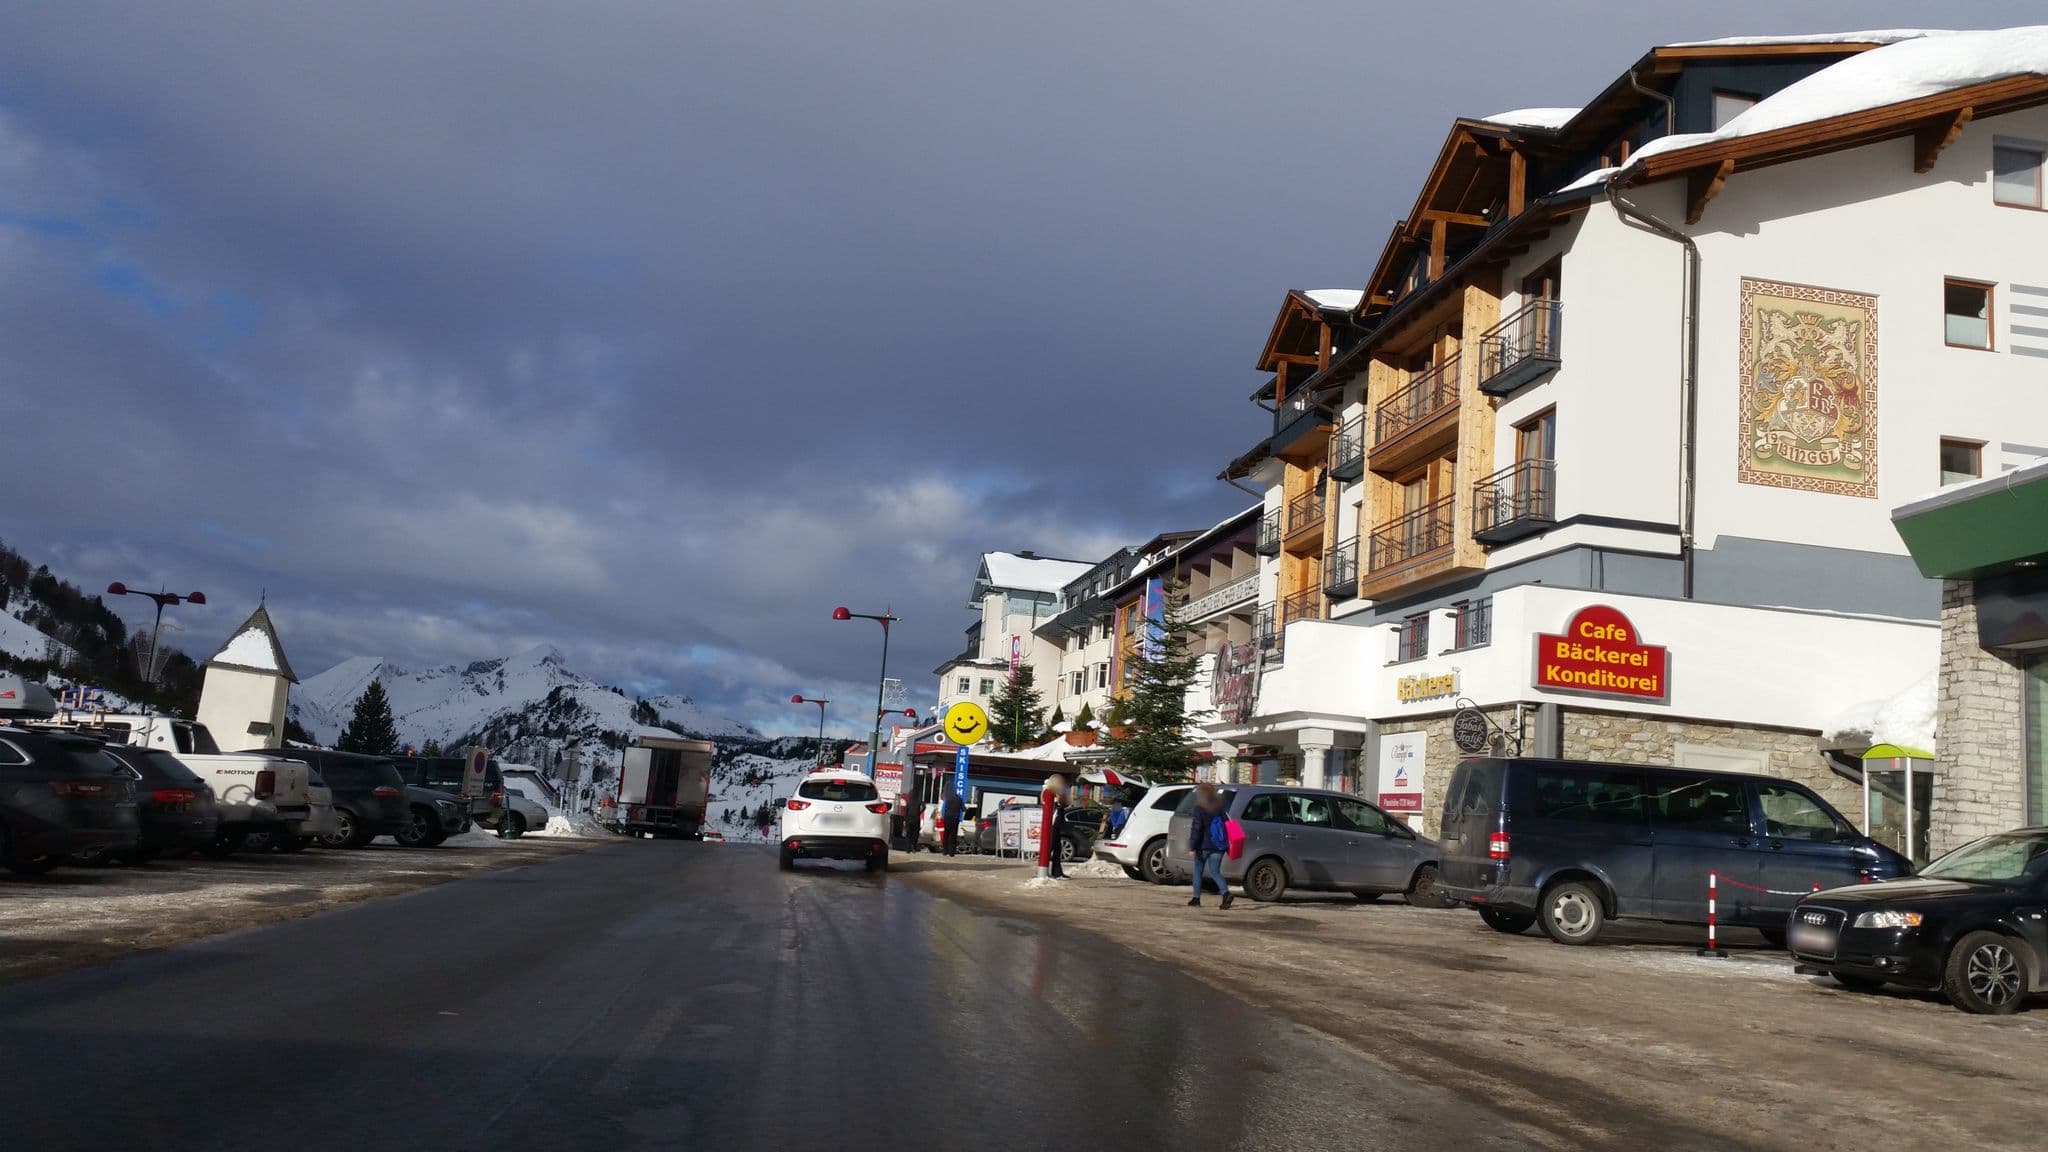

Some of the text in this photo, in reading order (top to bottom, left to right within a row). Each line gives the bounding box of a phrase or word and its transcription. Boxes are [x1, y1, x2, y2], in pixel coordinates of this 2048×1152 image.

[1579, 621, 1627, 642] Cafe
[1556, 641, 1649, 667] Bäckerei
[1546, 664, 1658, 692] Konditorei
[956, 748, 967, 797] SKISCH
